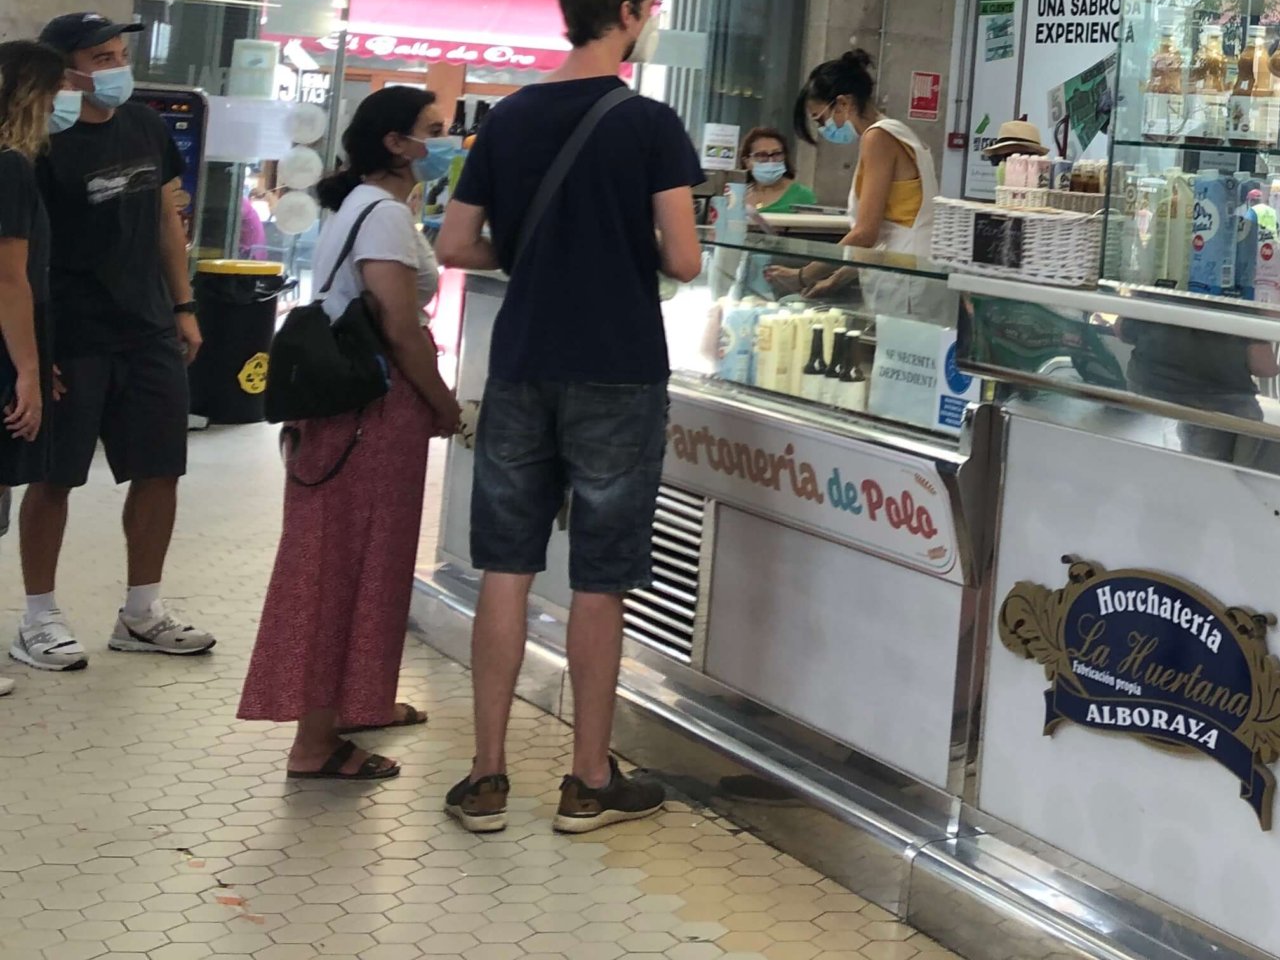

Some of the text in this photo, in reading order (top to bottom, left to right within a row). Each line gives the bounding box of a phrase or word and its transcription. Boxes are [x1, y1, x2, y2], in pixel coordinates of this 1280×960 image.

[828, 467, 862, 515] de
[861, 478, 938, 540] Polo
[1096, 585, 1223, 654] Horchatería
[1066, 613, 1250, 718] La Huertana
[1072, 660, 1142, 697] Fabricación propia
[1085, 703, 1220, 750] ALBORAYA
